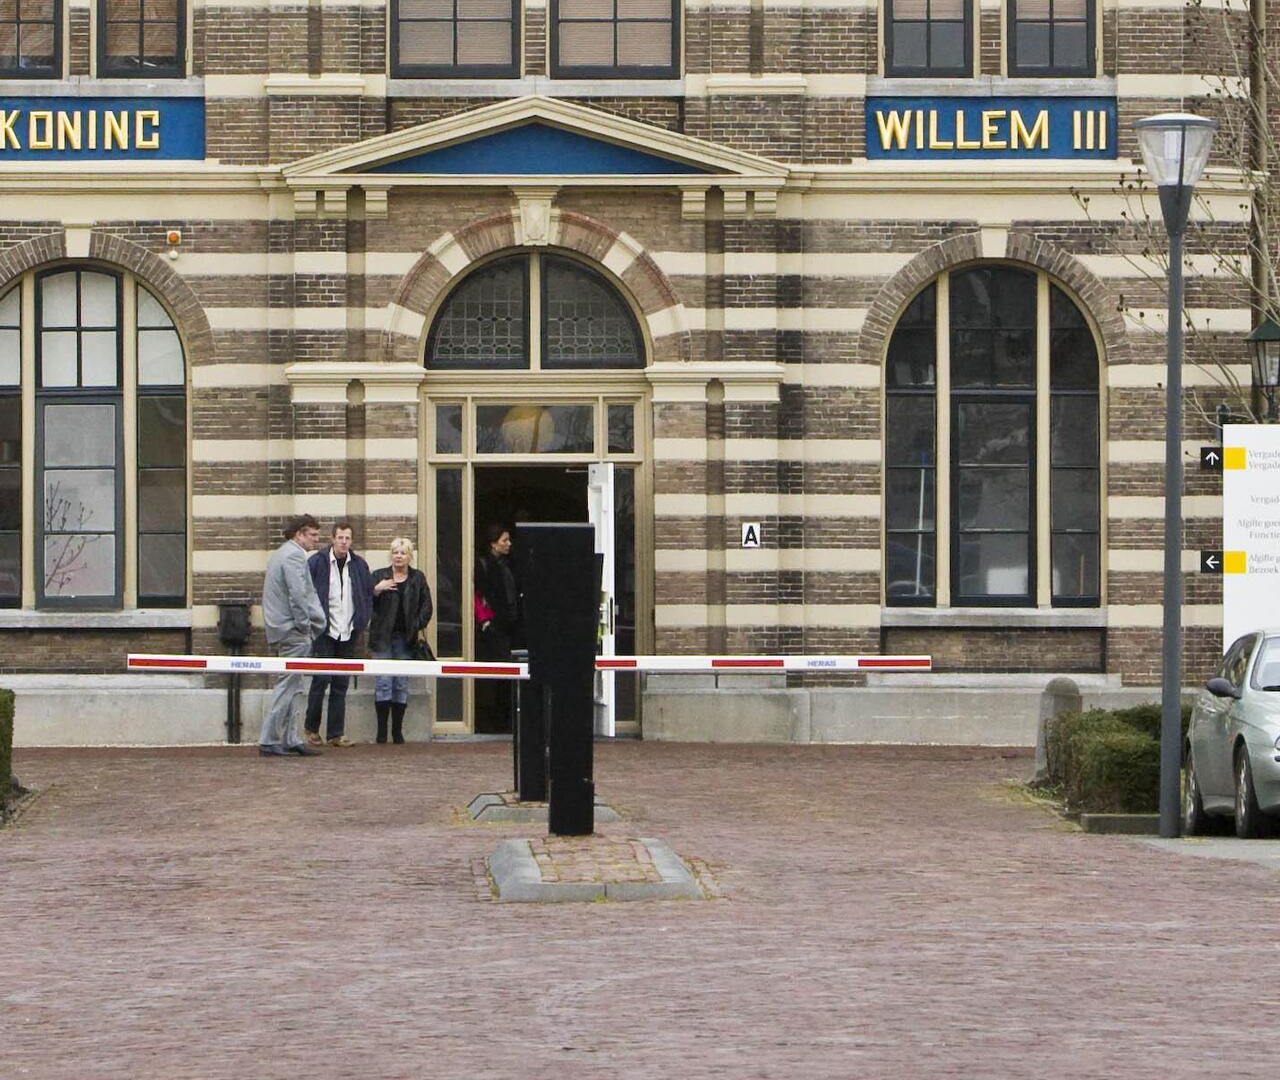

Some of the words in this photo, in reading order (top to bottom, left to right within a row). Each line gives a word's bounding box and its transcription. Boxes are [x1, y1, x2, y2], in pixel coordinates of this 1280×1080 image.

[875, 109, 1050, 150] WILLEM
[1073, 110, 1107, 150] III
[743, 525, 759, 545] A
